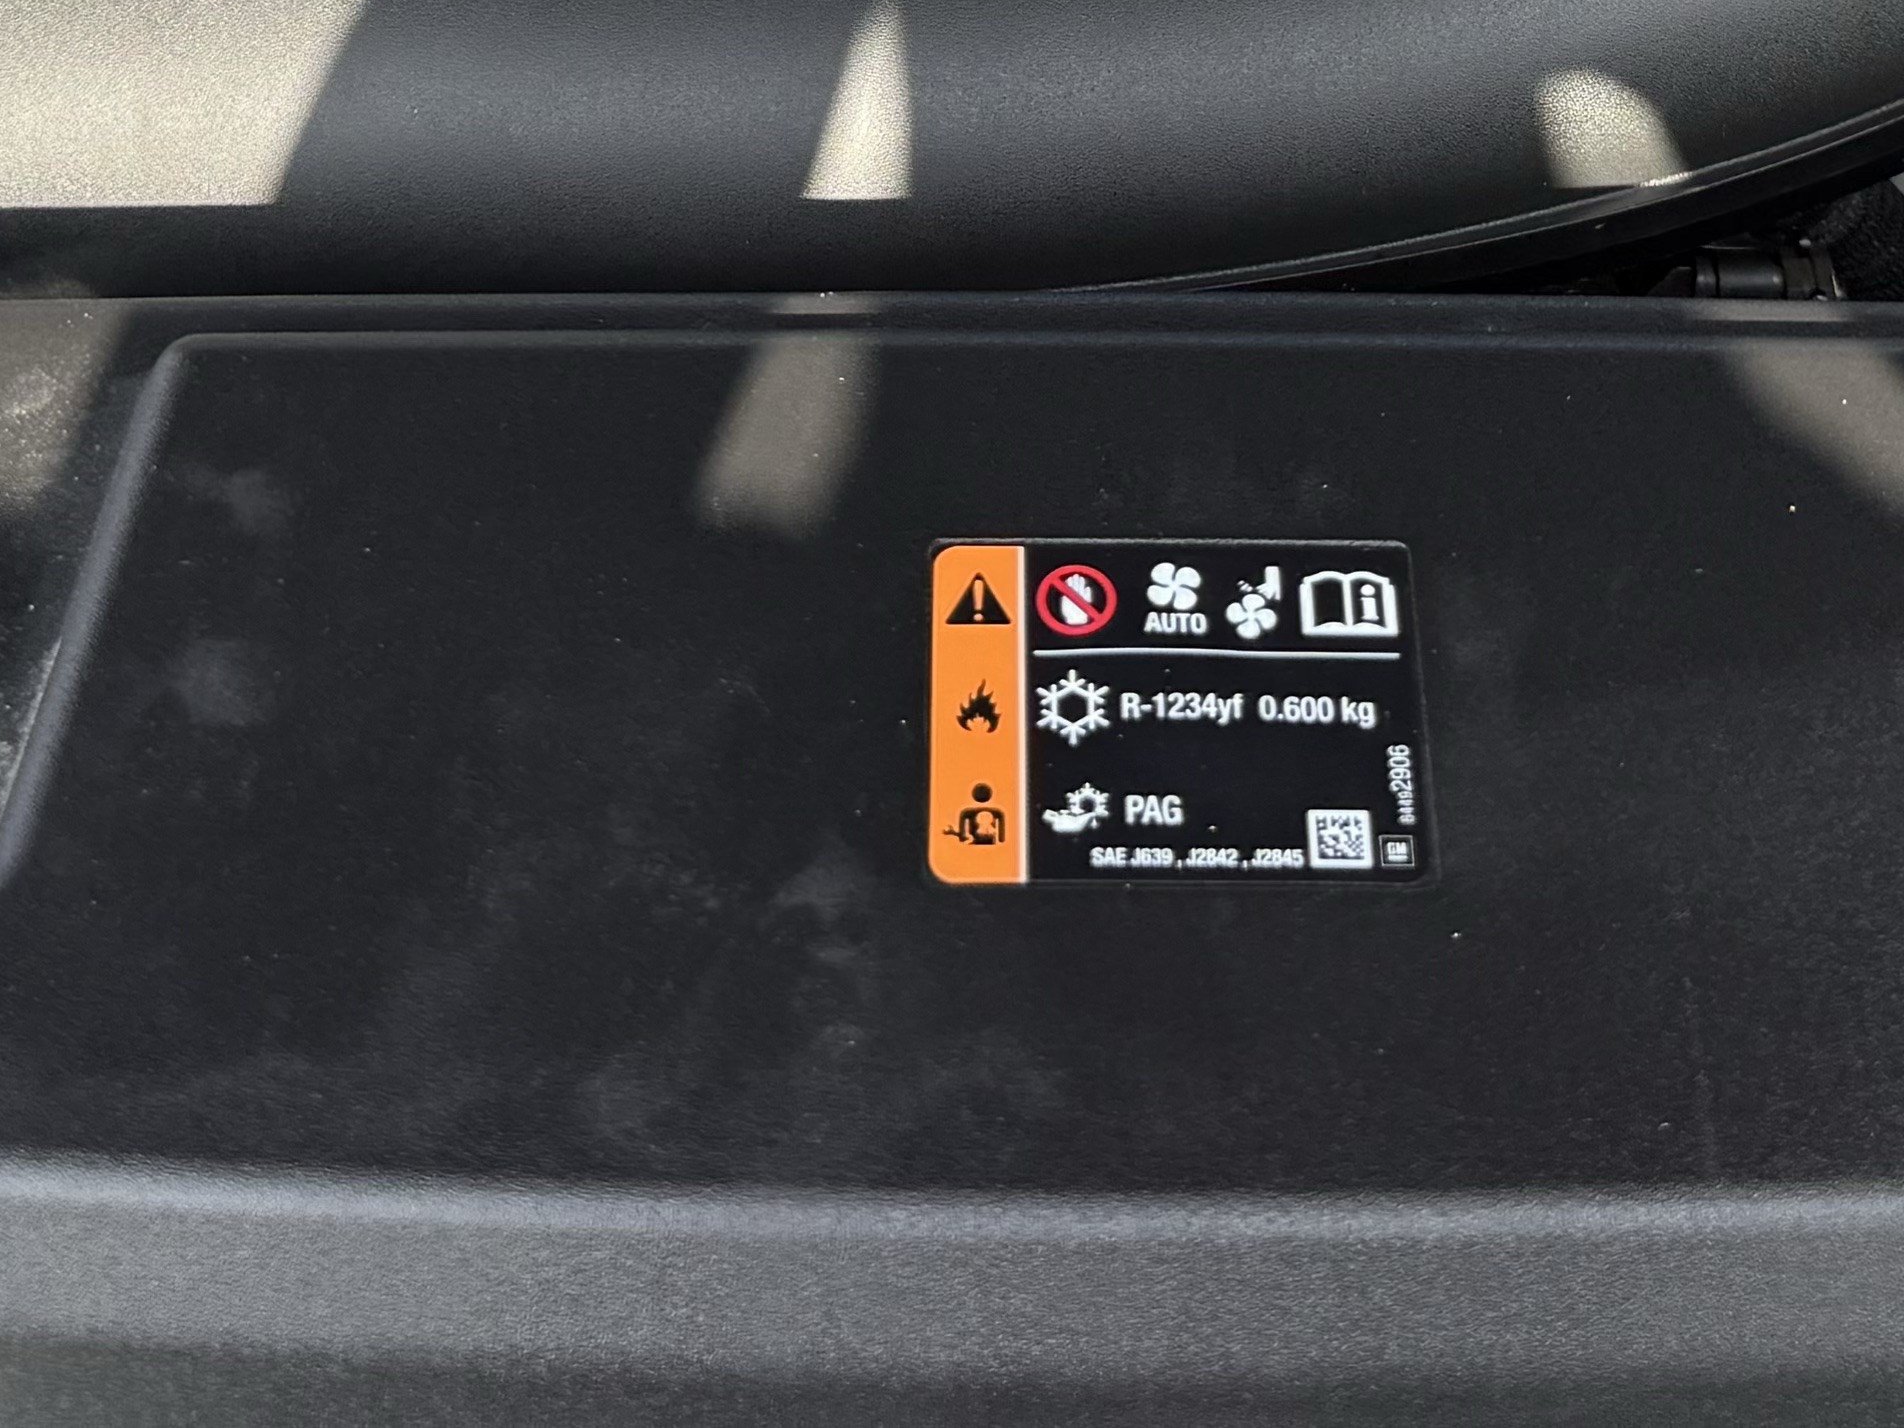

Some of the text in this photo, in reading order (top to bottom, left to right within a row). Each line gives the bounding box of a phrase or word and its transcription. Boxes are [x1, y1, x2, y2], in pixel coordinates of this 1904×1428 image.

[1143, 612, 1208, 635] AUTO
[1119, 695, 1377, 730] R-1234yf 0.600 kg
[1124, 795, 1184, 825] PAG
[1089, 846, 1127, 868] SAE
[1251, 848, 1305, 869] J2845
